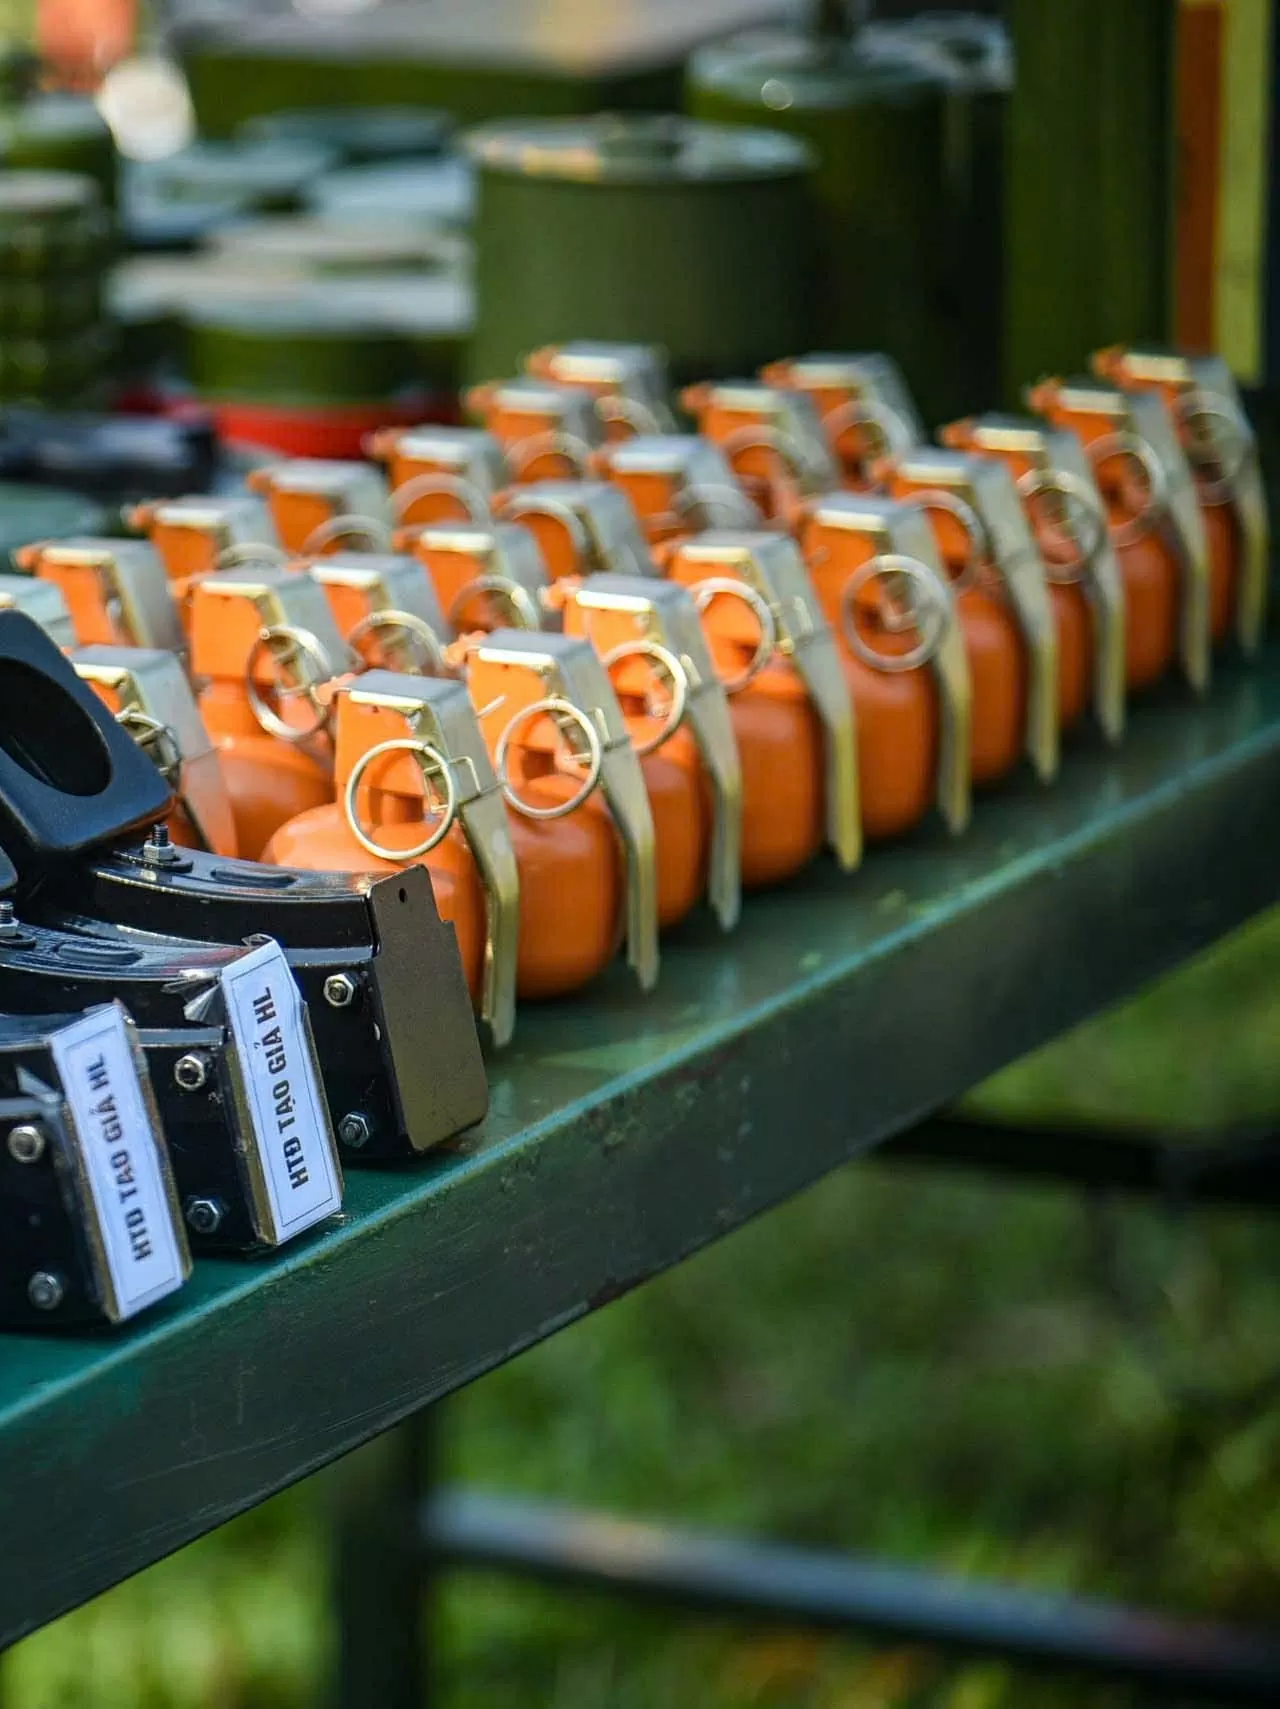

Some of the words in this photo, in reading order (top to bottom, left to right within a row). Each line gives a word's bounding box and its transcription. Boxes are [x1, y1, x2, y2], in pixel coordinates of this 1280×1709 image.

[252, 987, 277, 1025] HL
[86, 1053, 110, 1091] HL
[254, 1026, 287, 1075] GIẢ
[273, 1079, 296, 1134] TẠO
[283, 1136, 310, 1190] HTĐ
